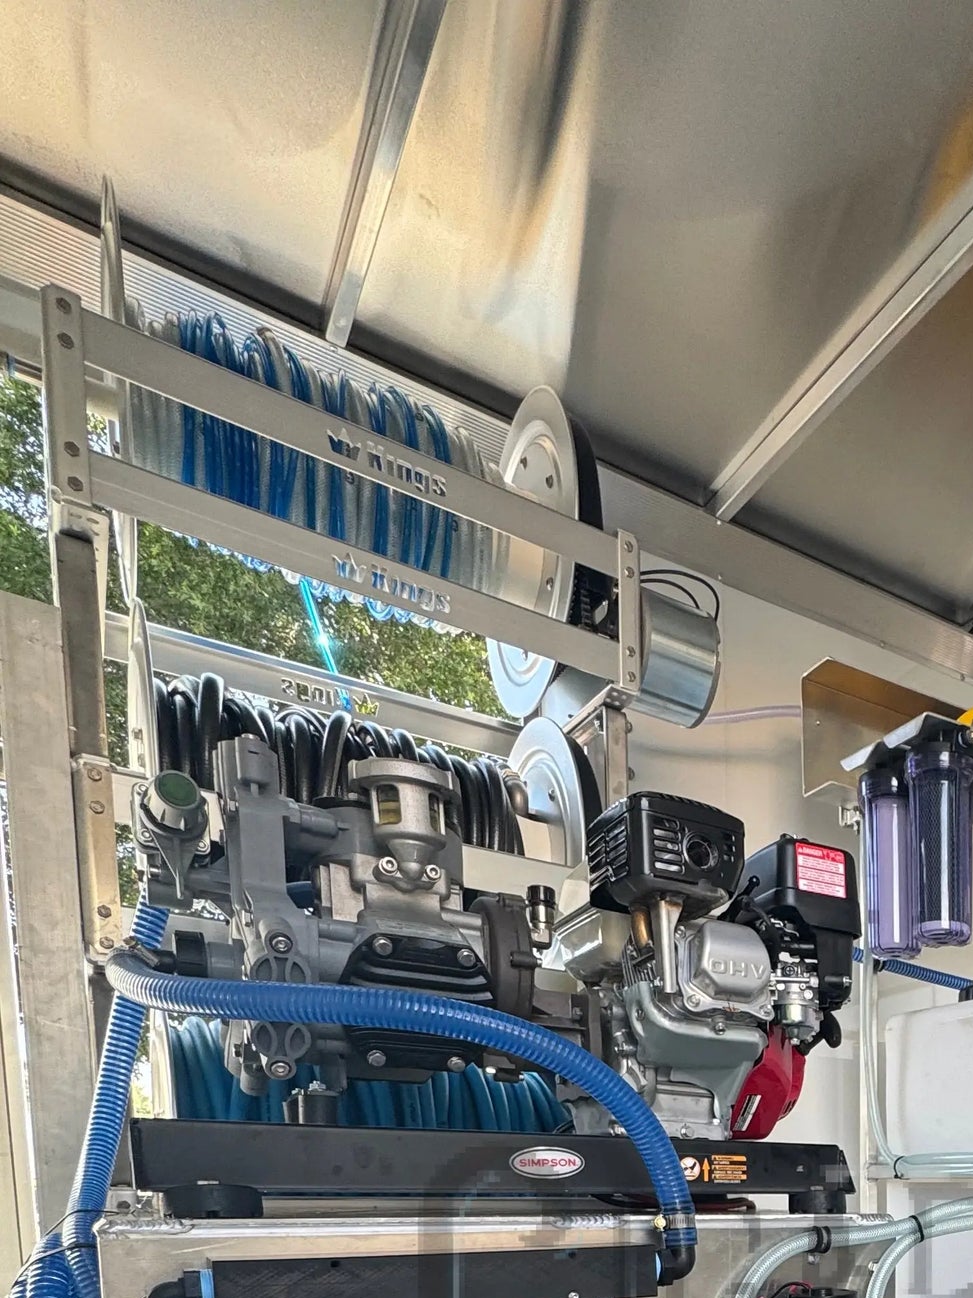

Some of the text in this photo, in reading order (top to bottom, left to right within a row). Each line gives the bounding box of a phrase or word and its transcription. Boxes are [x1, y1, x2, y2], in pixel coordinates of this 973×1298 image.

[366, 441, 447, 497] Kings
[371, 564, 451, 613] Kings
[709, 958, 767, 979] OHV
[519, 1158, 577, 1168] SIMPSON
